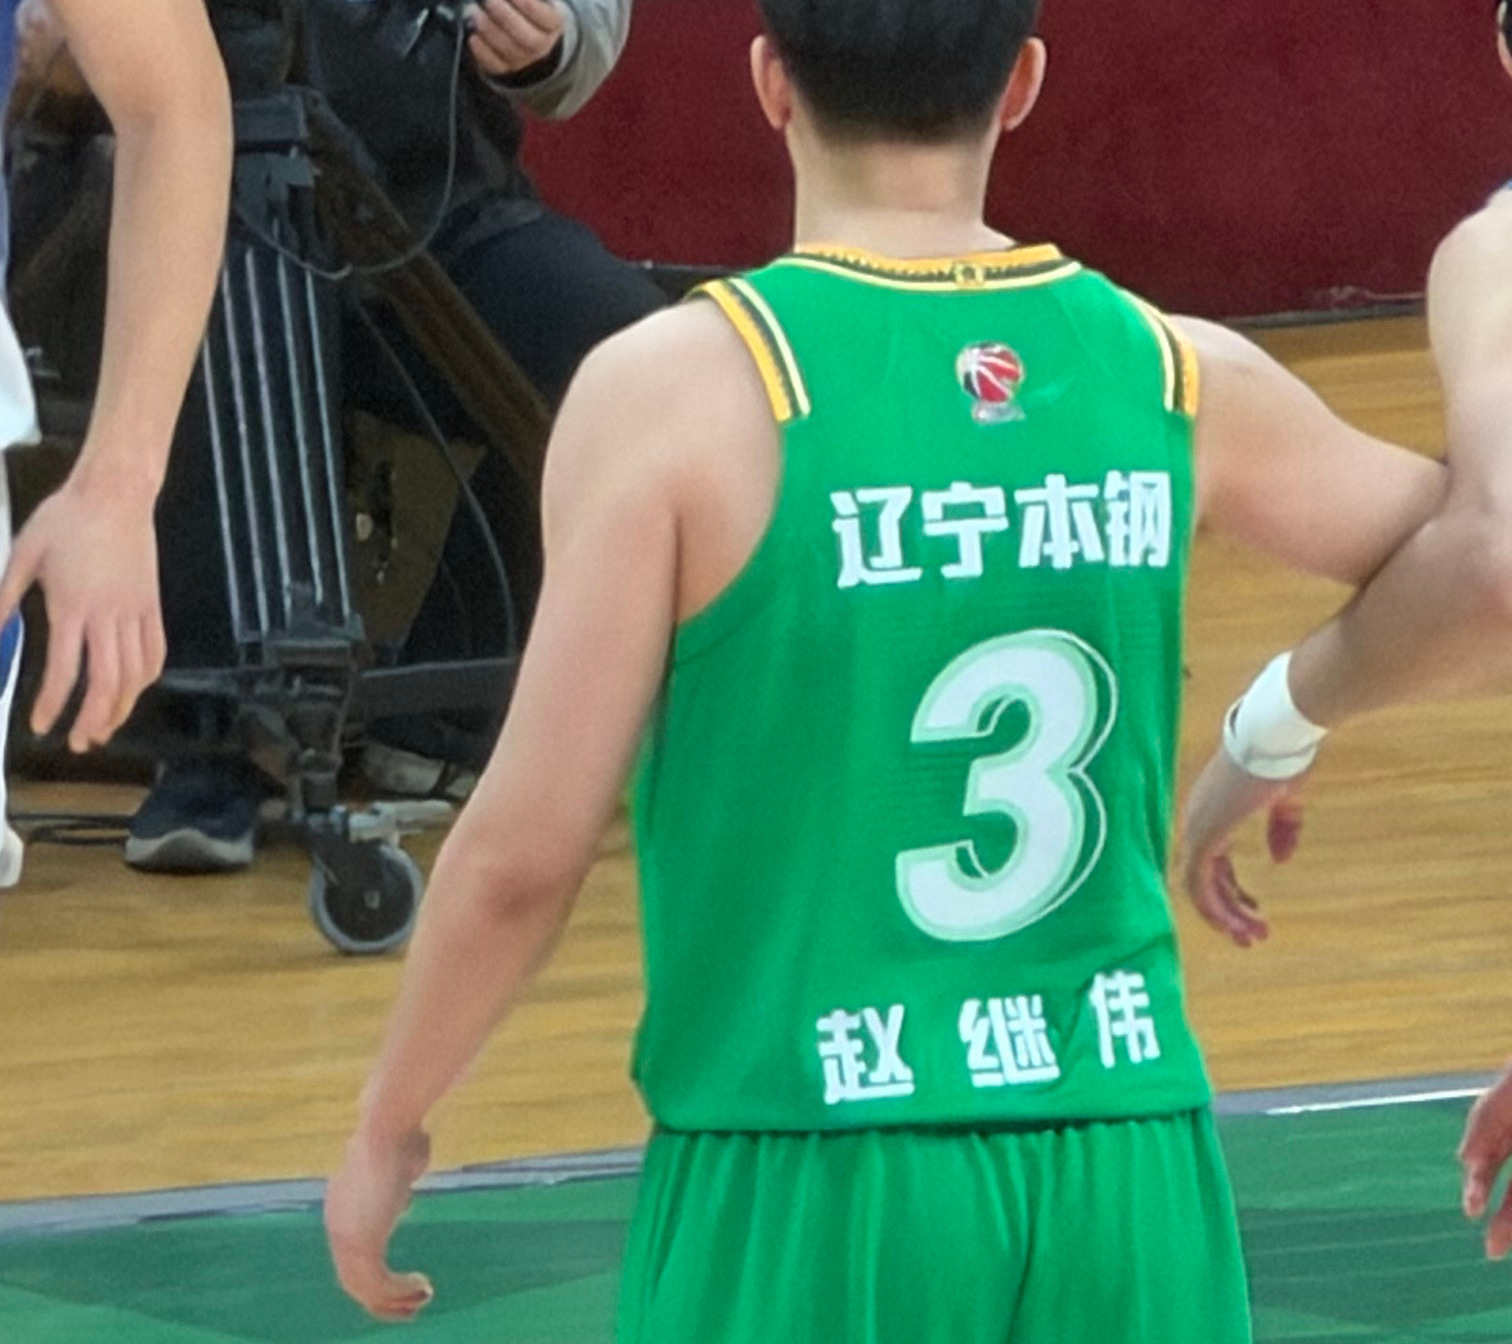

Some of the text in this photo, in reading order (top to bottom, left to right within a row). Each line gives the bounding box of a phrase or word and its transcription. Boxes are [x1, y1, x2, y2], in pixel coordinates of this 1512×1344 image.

[830, 470, 1174, 589] 辽宁本钢
[895, 628, 1118, 943] 3
[816, 970, 1161, 1105] 赵继伟
